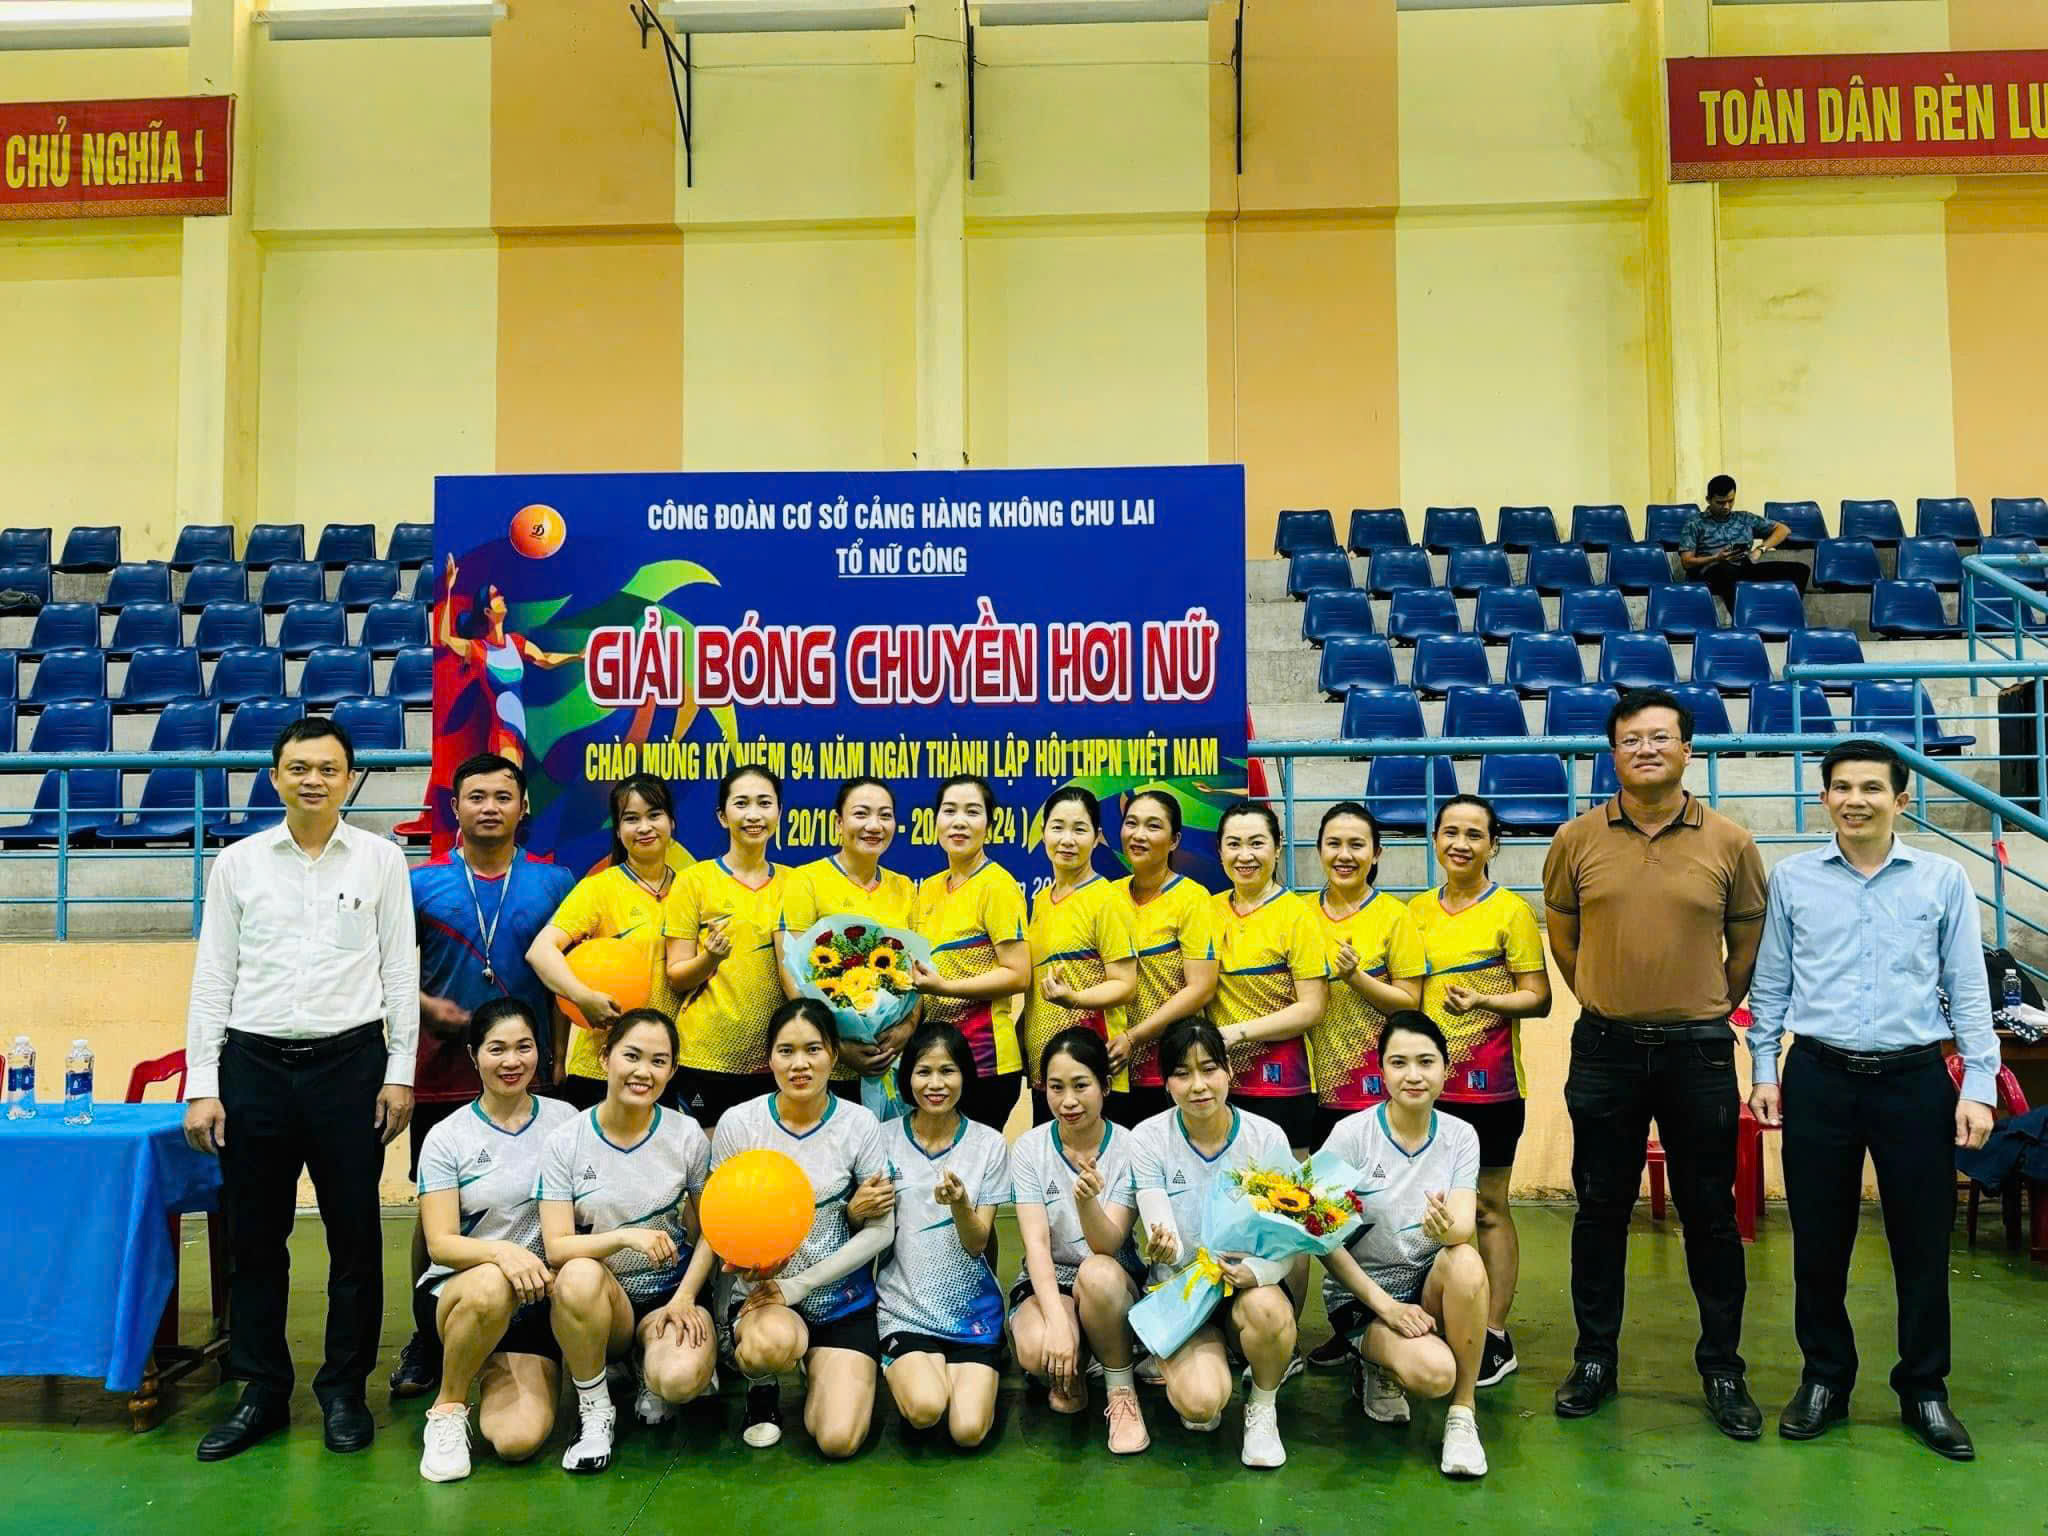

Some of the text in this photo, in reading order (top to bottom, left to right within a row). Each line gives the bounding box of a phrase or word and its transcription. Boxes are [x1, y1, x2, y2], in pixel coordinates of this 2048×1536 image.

[1699, 77, 1805, 146] TOÀN
[1817, 75, 1902, 143] DÂN
[1913, 73, 1996, 141] RÈN
[5, 115, 71, 189] CHỦ
[81, 119, 183, 186] NGHĨA
[648, 495, 1155, 531] CÔNG ĐOÀN CƠ SỞ CẢNG HÀNG KHÔNG CHU LAI
[836, 538, 967, 574] TỔ NỮ CÔNG
[585, 596, 1219, 706] GIẢI BÓNG CHUYỀN HƠI NỮ
[585, 735, 637, 781] CHÀO
[642, 735, 701, 781] MỪNG
[706, 730, 732, 780] KỶ
[791, 742, 815, 780] 94
[820, 734, 865, 779] NĂM
[870, 733, 921, 778] NGÀY
[926, 733, 989, 778] THÀNH
[994, 732, 1030, 786] LẬP
[1035, 732, 1067, 785] HỘI
[1072, 739, 1122, 777] LHPN
[1128, 730, 1168, 785] VIỆT
[1173, 738, 1219, 777] NAM
